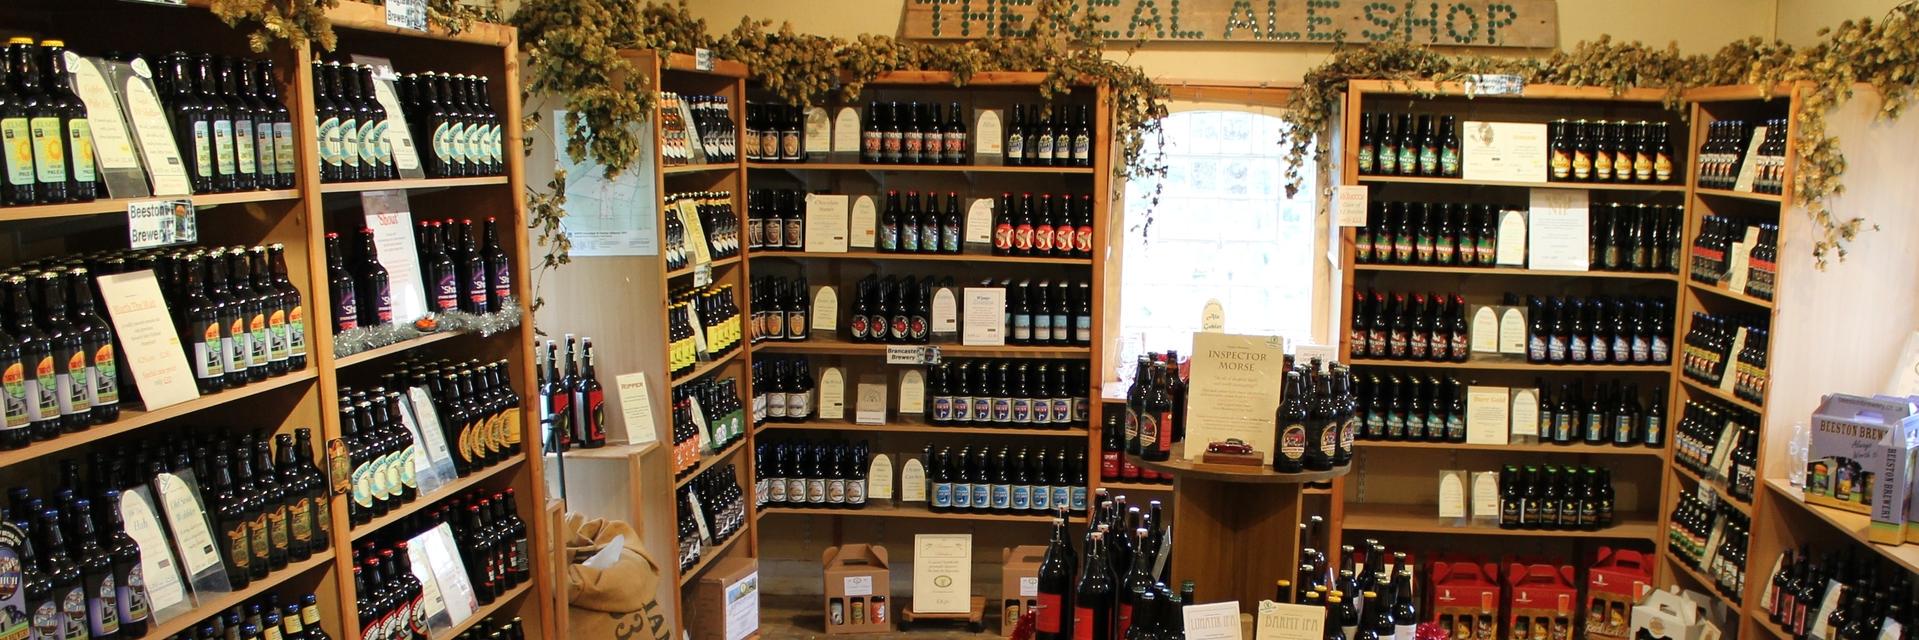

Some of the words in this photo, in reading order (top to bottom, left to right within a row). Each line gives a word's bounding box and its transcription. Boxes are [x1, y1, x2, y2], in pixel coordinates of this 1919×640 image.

[915, 0, 1034, 37] THE
[1223, 0, 1344, 41] ALE
[1361, 2, 1517, 44] SHOP
[130, 204, 165, 219] Beeston
[891, 354, 916, 362] Brewery
[1208, 350, 1268, 361] INSPECTOR
[1219, 361, 1255, 372] MORSE
[621, 382, 643, 390] RIPPER
[1820, 420, 1857, 437] BEESTON
[1860, 426, 1889, 442] BREW
[1885, 448, 1898, 483] BEESTON
[1881, 484, 1894, 519] BREWERY
[1302, 618, 1318, 631] IPA
